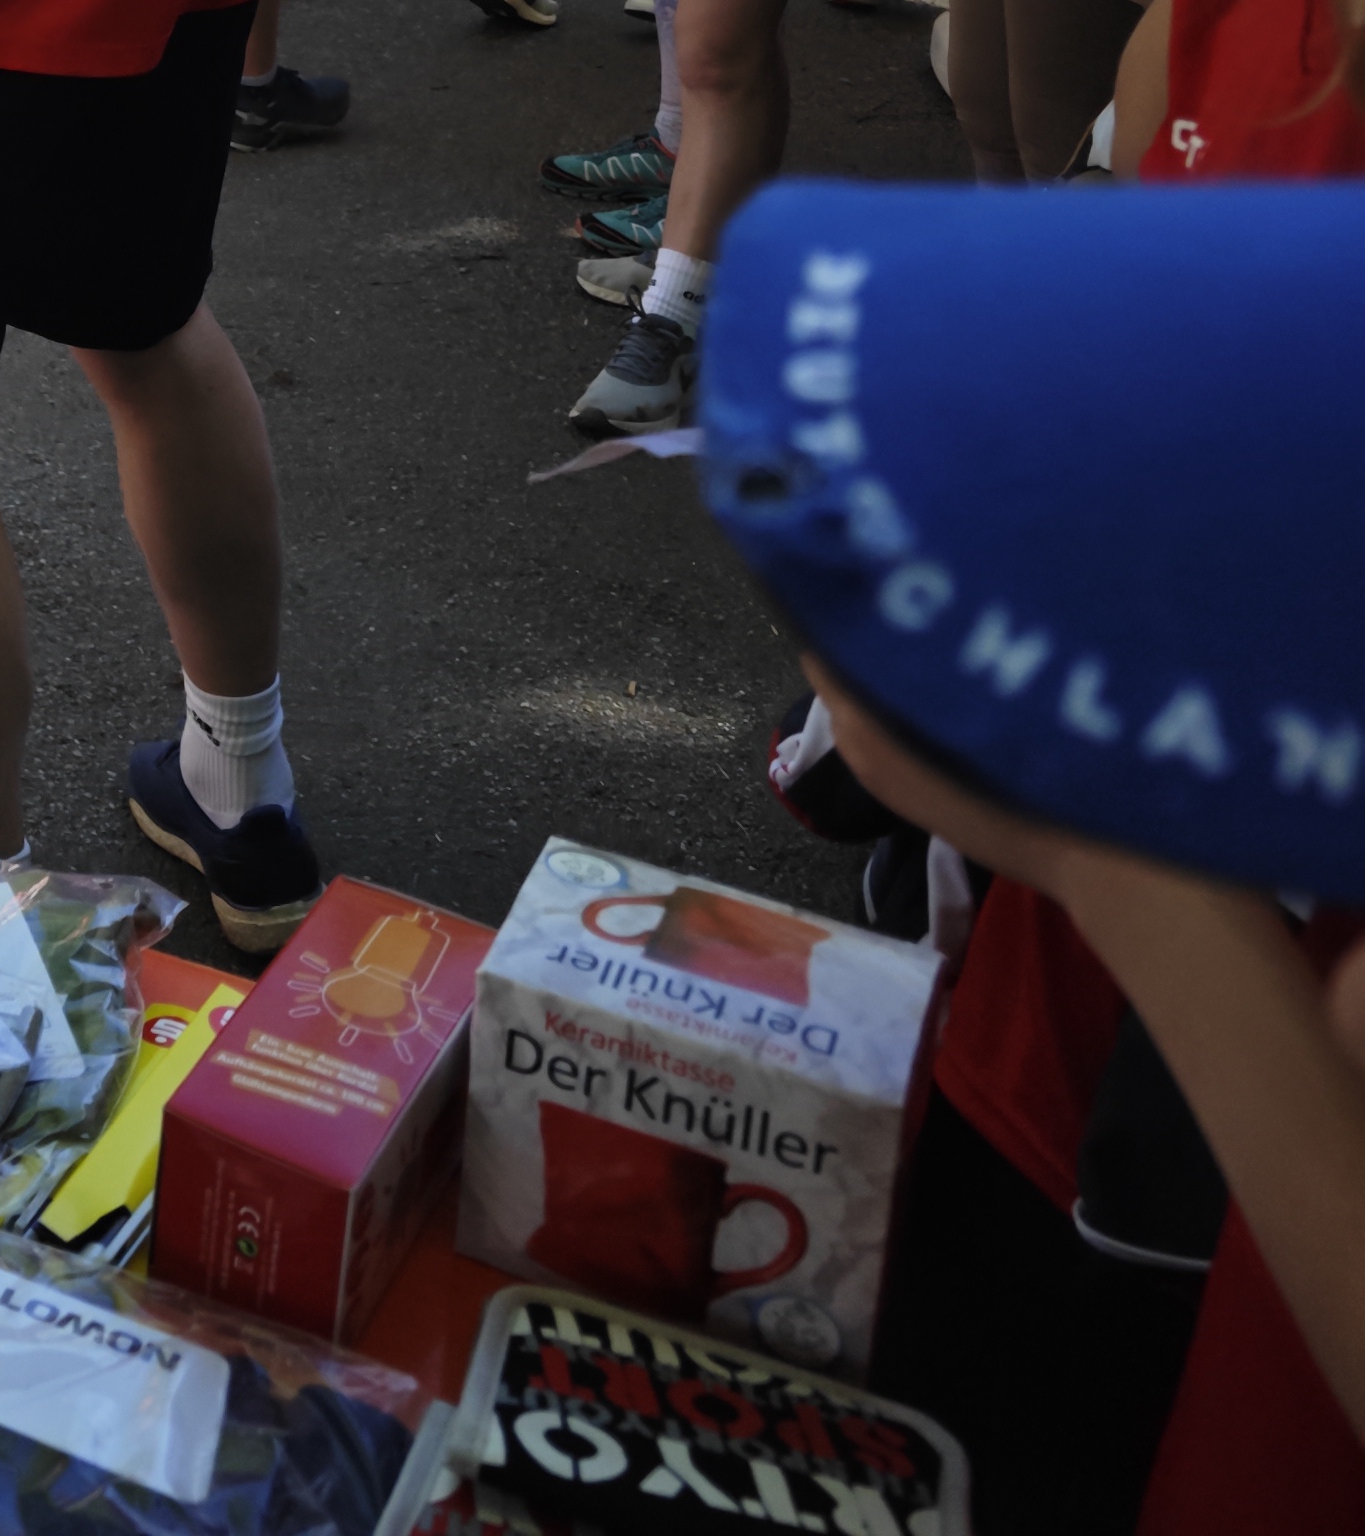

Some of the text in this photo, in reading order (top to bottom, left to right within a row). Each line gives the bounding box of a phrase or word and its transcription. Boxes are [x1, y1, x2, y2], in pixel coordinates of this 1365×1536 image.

[780, 249, 1365, 800] DEUTSCHLAN
[543, 1009, 737, 1093] Keramiktasse
[544, 942, 840, 1058] Der Knüller
[504, 1028, 840, 1176] Der Knüller
